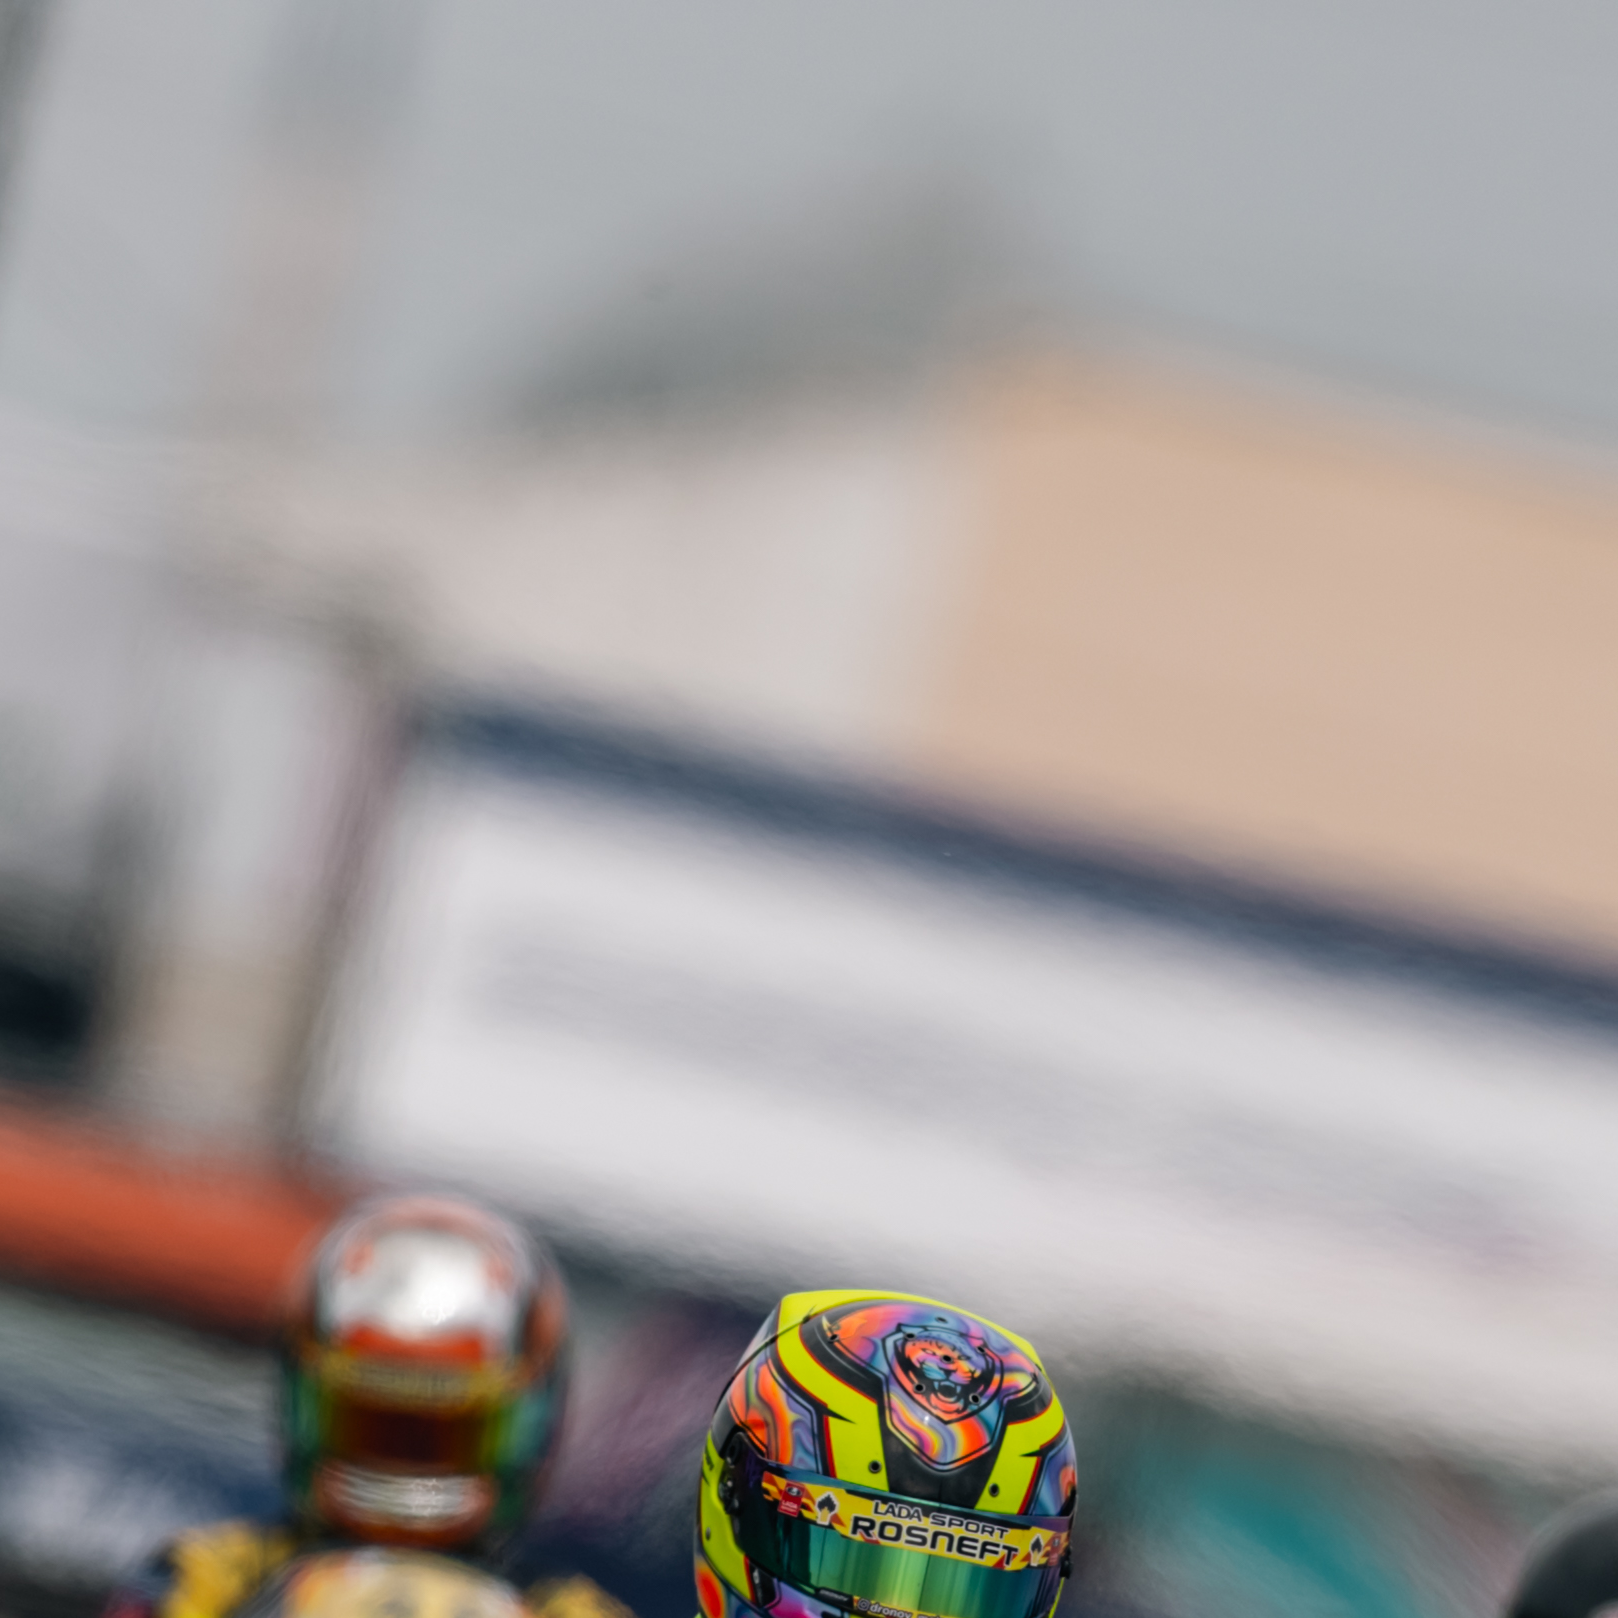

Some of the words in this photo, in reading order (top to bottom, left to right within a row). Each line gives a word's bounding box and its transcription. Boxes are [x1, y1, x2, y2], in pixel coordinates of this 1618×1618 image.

[851, 1516, 1019, 1566] ROSNEFT
[874, 1501, 922, 1522] LADA
[930, 1512, 1009, 1540] SPORT
